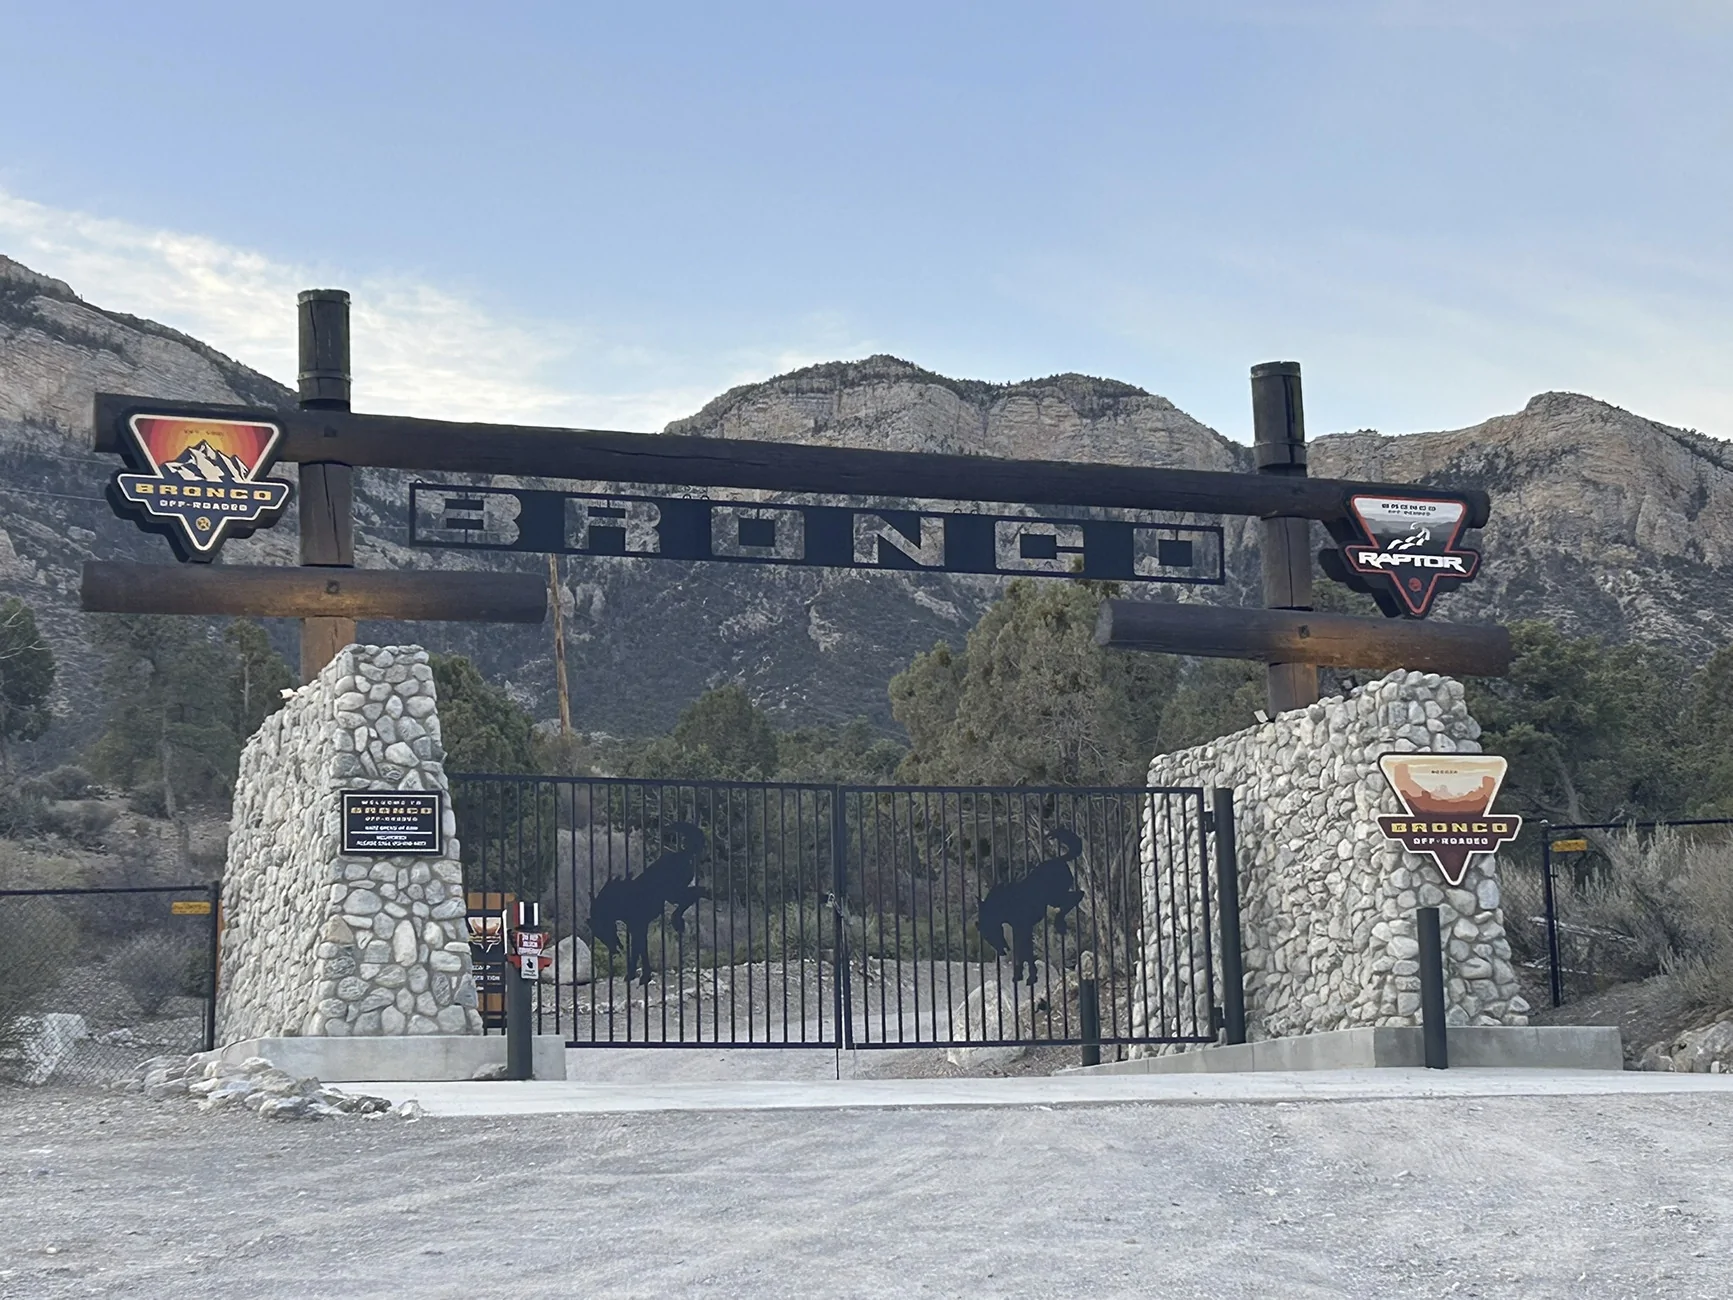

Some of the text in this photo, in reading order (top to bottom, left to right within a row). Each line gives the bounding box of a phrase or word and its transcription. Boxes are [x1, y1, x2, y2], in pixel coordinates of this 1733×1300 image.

[136, 483, 272, 501] BRONCO
[159, 499, 248, 512] OFF-ROADEO
[415, 488, 1221, 580] BRONCO
[1358, 551, 1467, 574] RAPTOR
[1391, 822, 1508, 833] BRONCO
[1413, 837, 1489, 845] OFF-ROADEO
